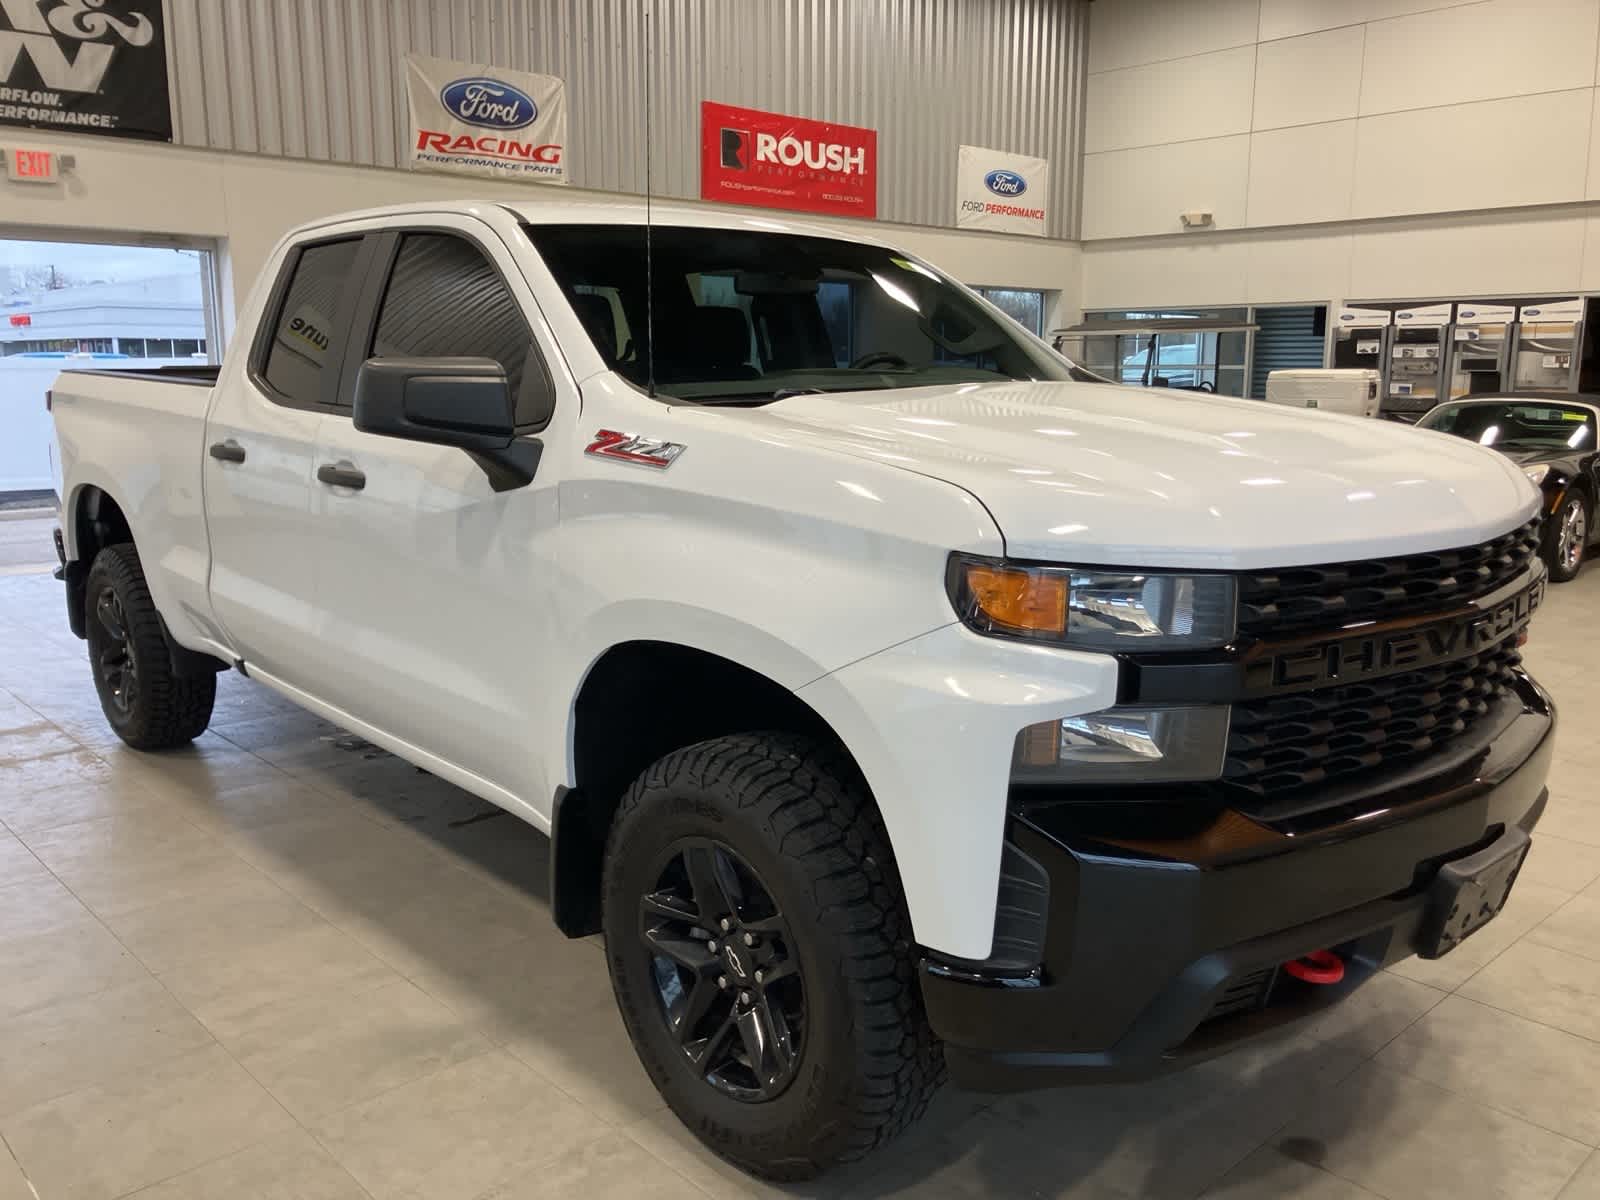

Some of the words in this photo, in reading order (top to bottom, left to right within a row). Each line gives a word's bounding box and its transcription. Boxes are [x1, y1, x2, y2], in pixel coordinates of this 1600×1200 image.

[460, 84, 520, 123] Ford
[416, 130, 562, 164] RACING
[756, 127, 866, 175] ROUSH
[15, 150, 52, 177] EXIT
[417, 153, 520, 170] PERFORMANCE
[524, 164, 563, 175] PARTS
[992, 174, 1018, 193] Ford
[961, 200, 984, 213] FORD
[985, 203, 1045, 220] PERFORMANCE
[1272, 578, 1547, 686] CHEVROLET
